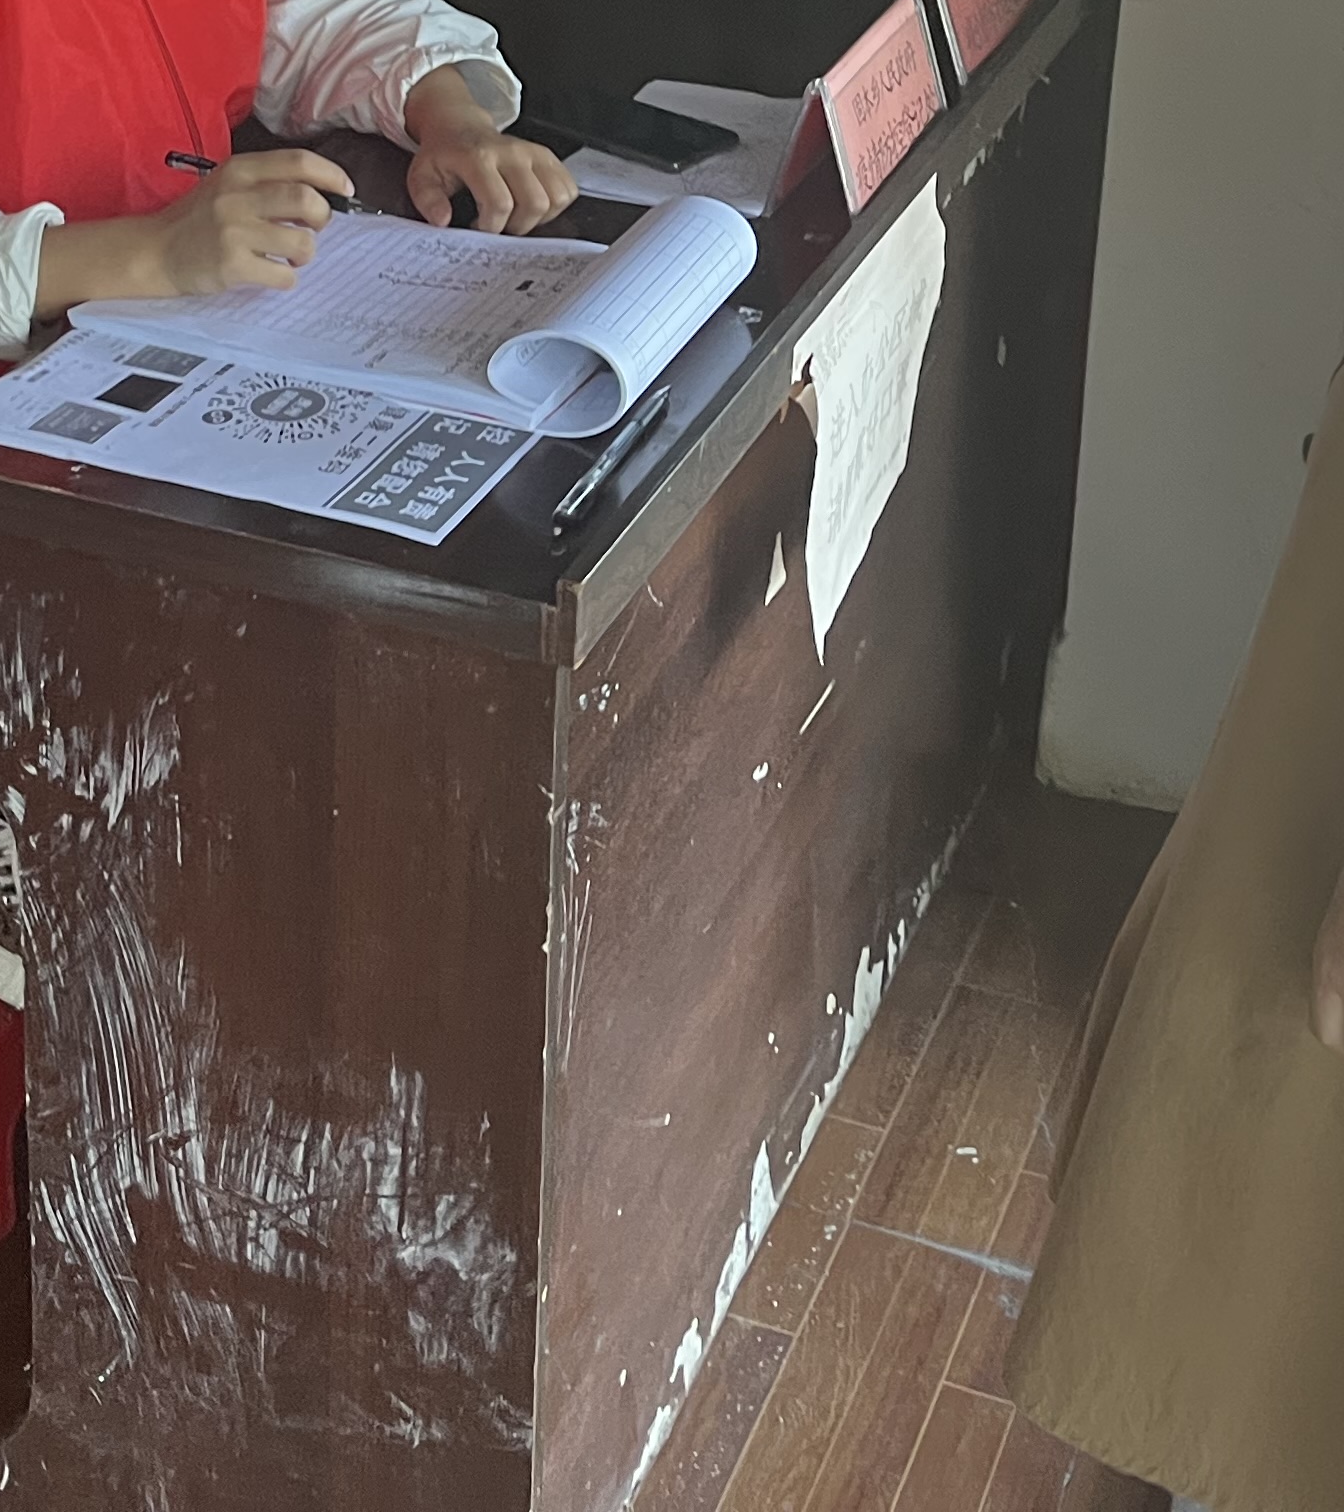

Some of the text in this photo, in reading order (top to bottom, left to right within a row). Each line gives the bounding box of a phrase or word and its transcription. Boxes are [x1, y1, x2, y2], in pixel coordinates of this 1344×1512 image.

[852, 40, 917, 127] 固本乡人民政府
[354, 440, 446, 510] 请您配合
[399, 449, 486, 521] 人人有责
